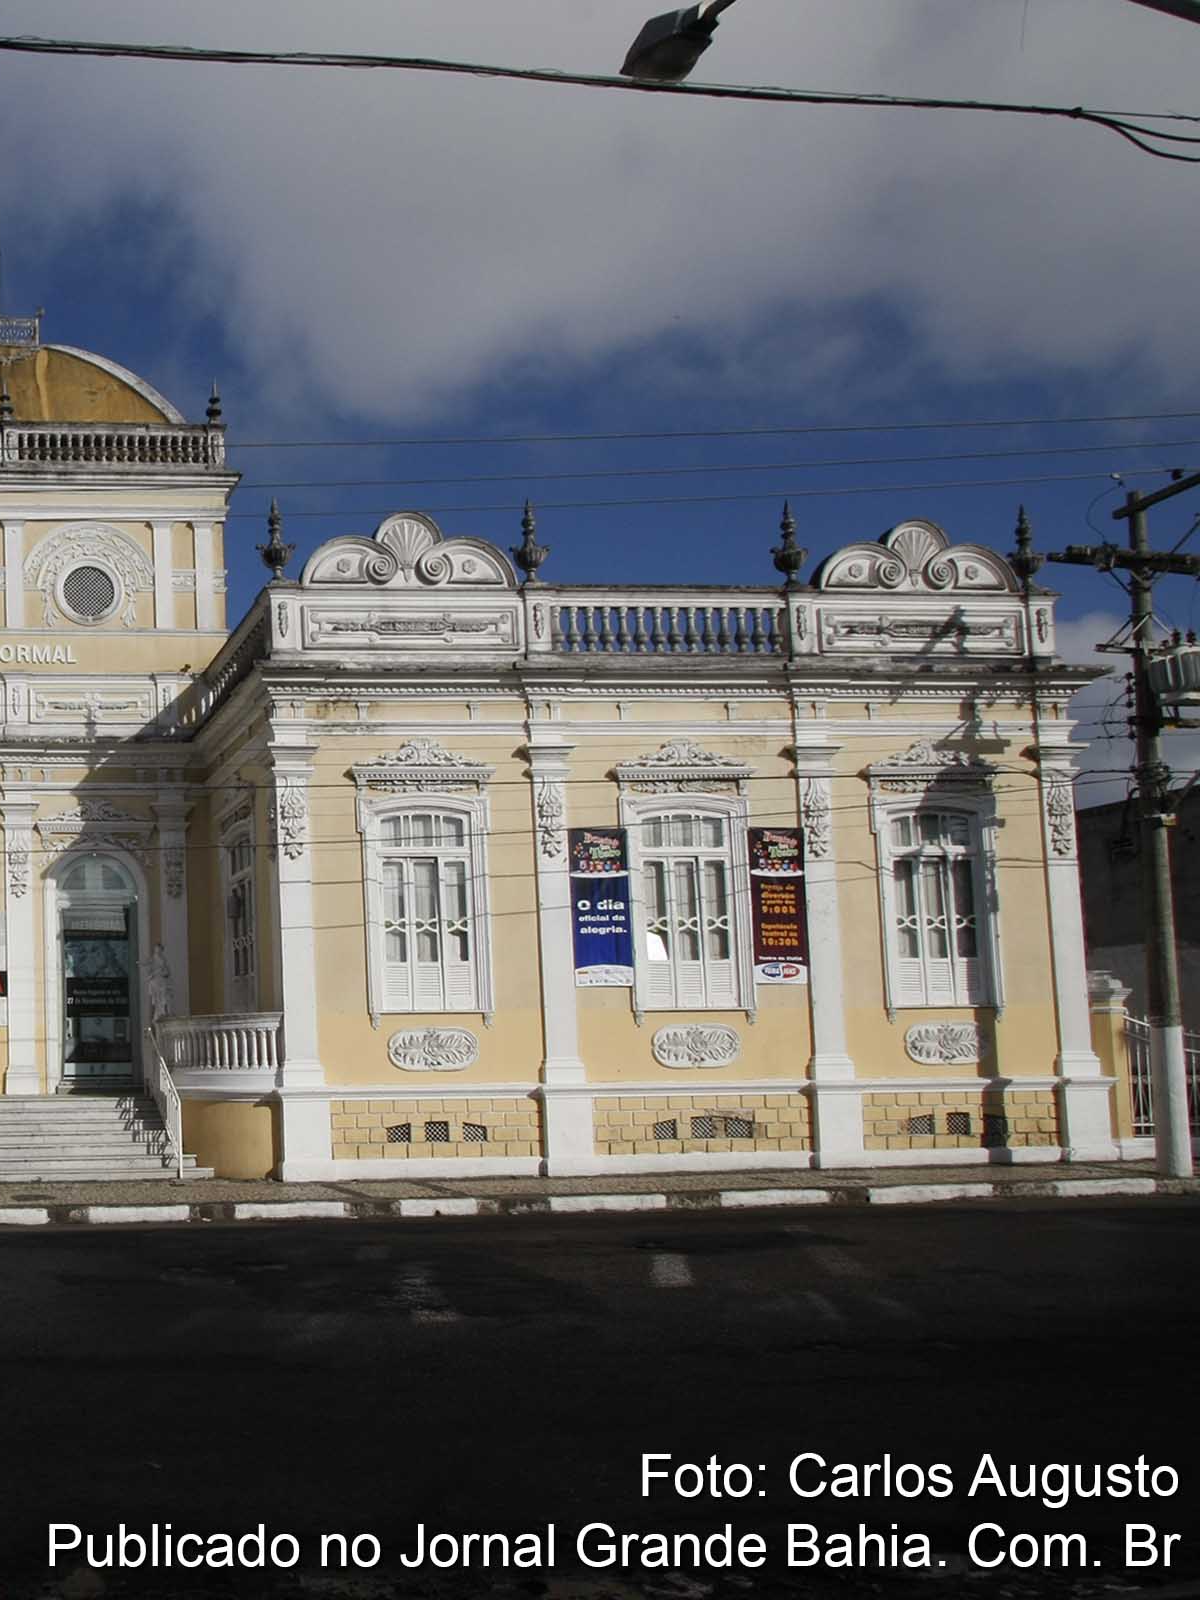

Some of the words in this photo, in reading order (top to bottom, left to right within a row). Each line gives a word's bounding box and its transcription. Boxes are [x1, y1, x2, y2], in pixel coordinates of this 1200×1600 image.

[577, 899, 591, 911] O
[596, 899, 625, 910] dia
[579, 925, 628, 935] alegria.
